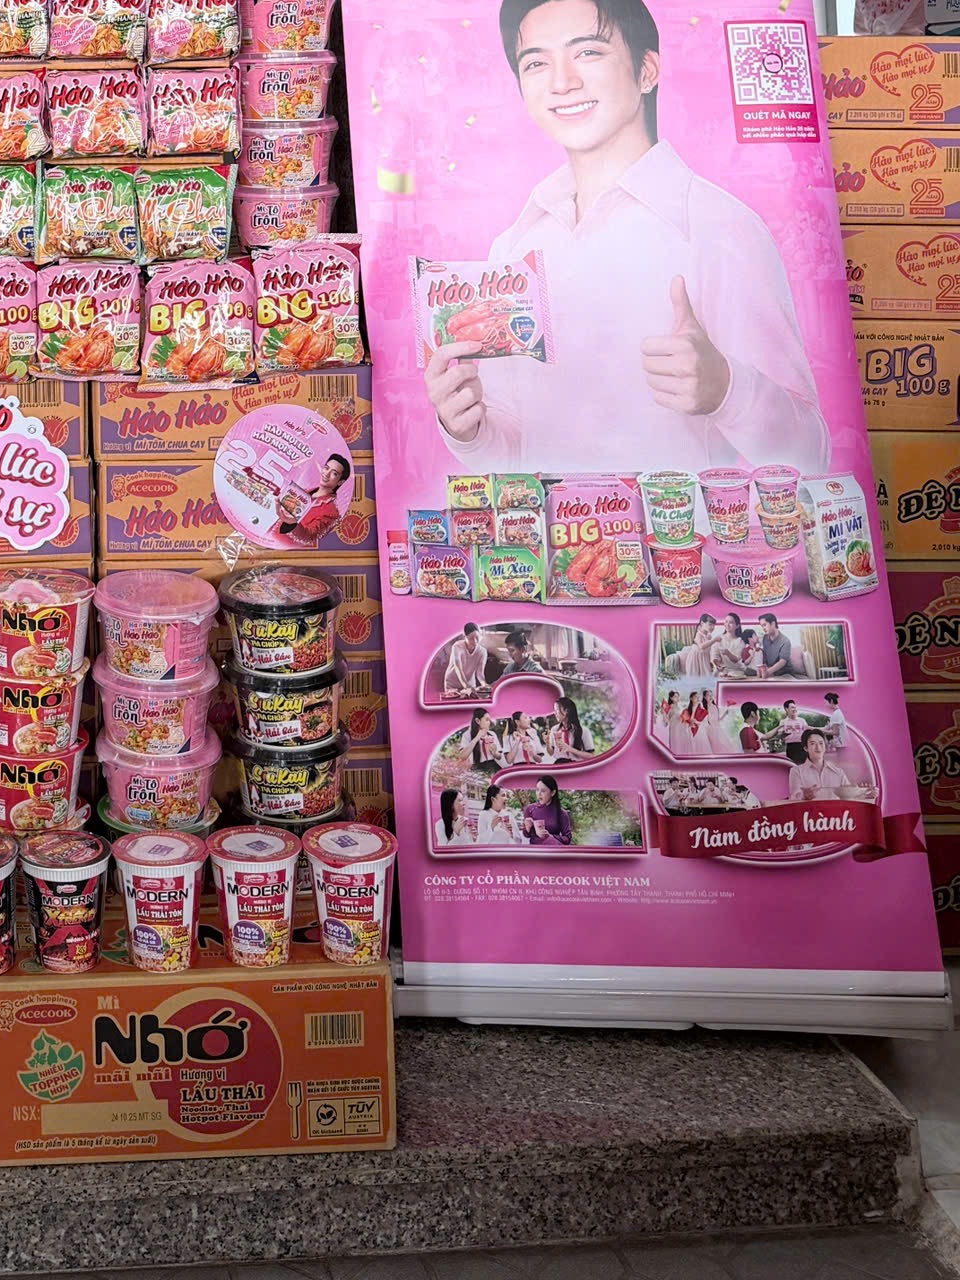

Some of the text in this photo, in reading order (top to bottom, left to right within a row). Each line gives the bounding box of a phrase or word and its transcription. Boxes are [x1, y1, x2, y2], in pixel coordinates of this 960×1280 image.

[744, 111, 769, 119] QUÉT
[772, 110, 786, 119] MÃ
[428, 265, 527, 308] Hảo Hảo
[867, 345, 937, 384] BIG
[896, 377, 934, 397] 100
[119, 395, 227, 438] Hảo Hảo
[167, 440, 188, 448] CHUA
[190, 440, 205, 448] CAY
[557, 493, 630, 518] Hảo Hảo
[898, 481, 945, 521] ĐỆ
[5, 496, 56, 537] sự
[550, 520, 631, 546] BIG 100
[4, 687, 63, 708] Nhớ
[690, 808, 857, 850] Năm đồng hành
[425, 871, 650, 887] CÔNG TY CỔ PHẦN ACECOOK VIỆT NAM
[227, 882, 289, 897] MODERN
[42, 894, 95, 907] MODERN
[236, 926, 260, 937] 100%
[14, 995, 76, 1008] Cook happiness
[97, 995, 120, 1010] Mì
[95, 1010, 248, 1066] Nhớ
[39, 1064, 64, 1079] NHIỀU
[95, 1067, 172, 1083] mãi mãi
[180, 1067, 226, 1081] Hương vị
[31, 1068, 80, 1094] TOPPING
[49, 1084, 70, 1096] HƠN
[182, 1082, 264, 1102] LẨU THÁI
[13, 1106, 40, 1121] NSX:
[181, 1103, 249, 1113] Noodles Thai
[128, 1113, 137, 1121] 25
[139, 1112, 149, 1120] MT
[151, 1112, 162, 1120] SG
[182, 1112, 265, 1124] Hotpot Flavour
